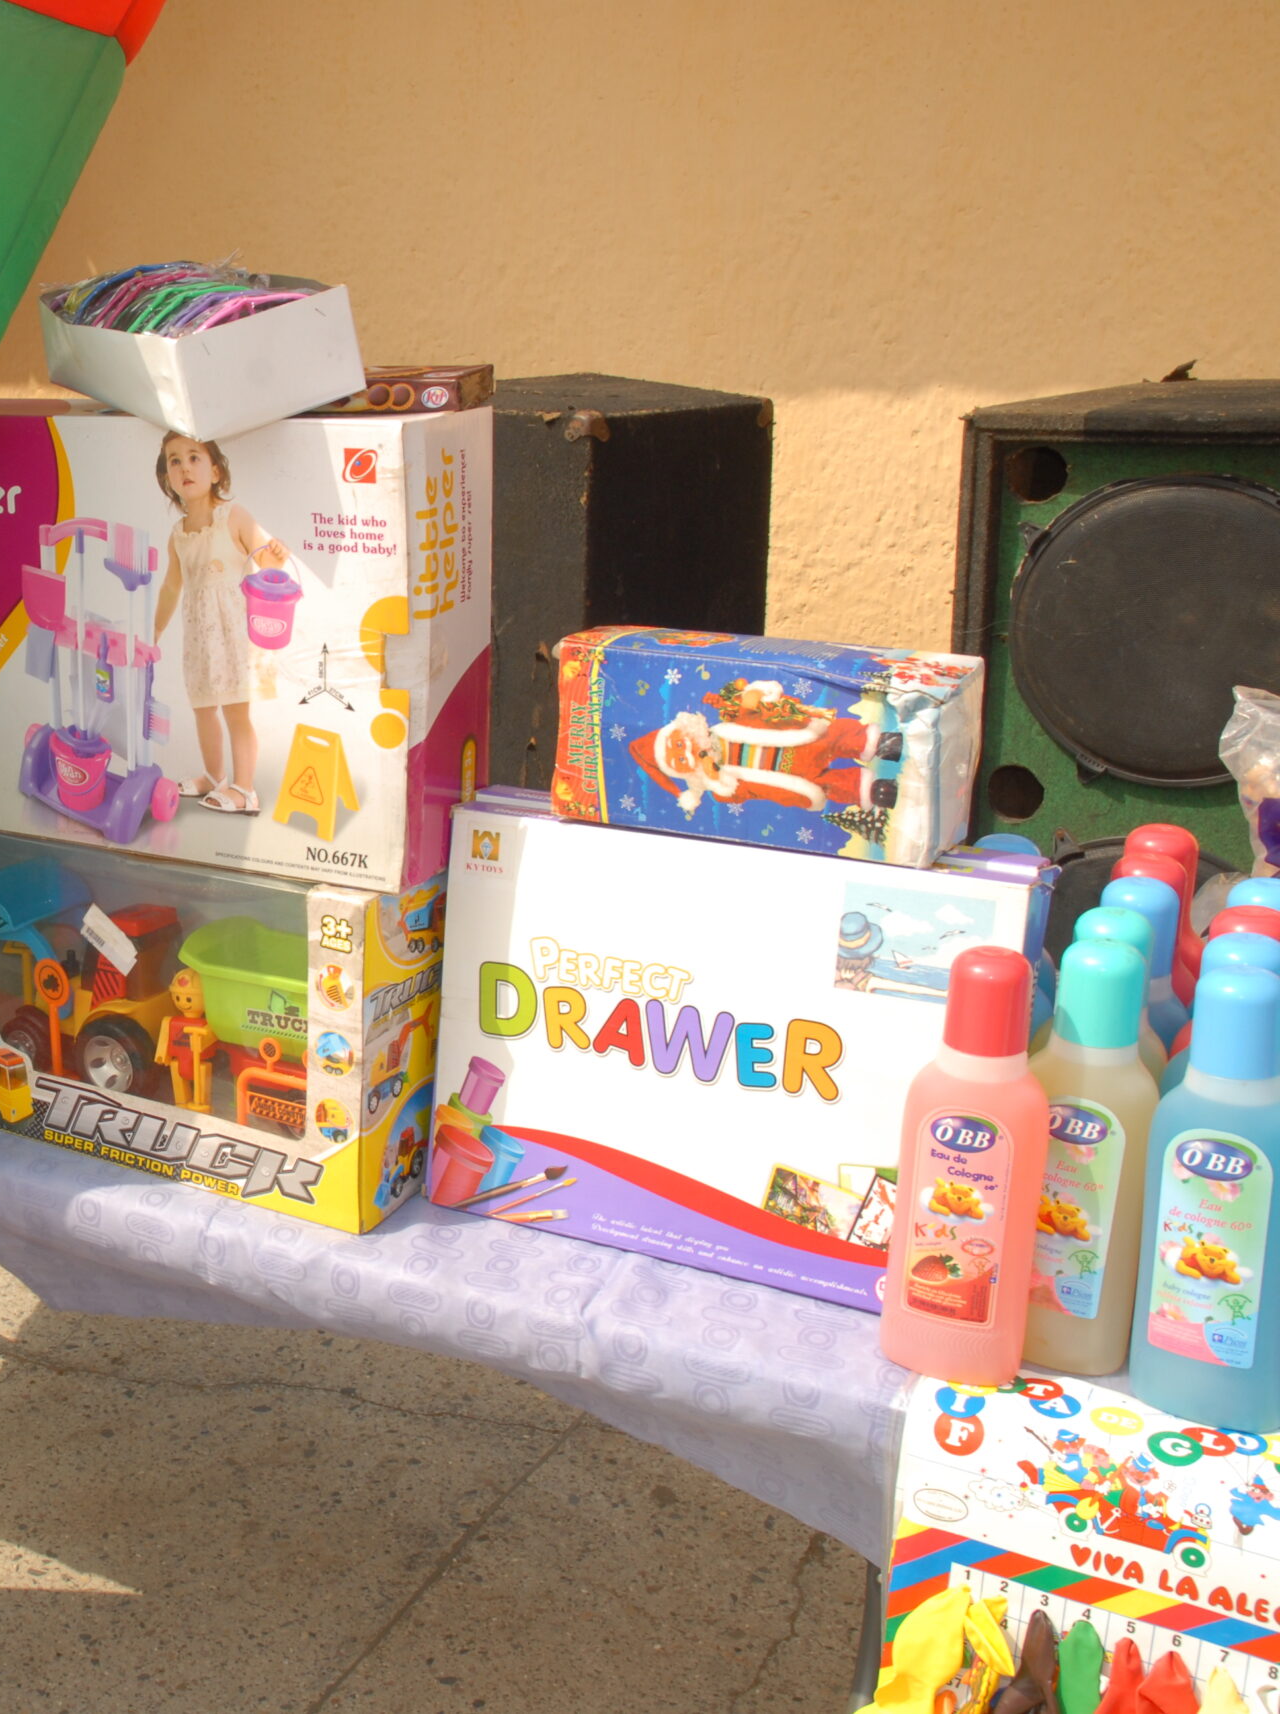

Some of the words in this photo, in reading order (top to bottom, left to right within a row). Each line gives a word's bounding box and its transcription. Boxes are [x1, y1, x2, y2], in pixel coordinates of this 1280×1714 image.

[311, 512, 334, 525] The
[337, 513, 357, 526] kid
[361, 515, 387, 528] who
[314, 526, 346, 539] loves
[350, 528, 384, 541] home
[439, 448, 460, 615] helper
[303, 540, 313, 551] is
[317, 543, 324, 551] a
[328, 542, 358, 554] good
[362, 543, 397, 557] baby!
[413, 475, 439, 621] Little
[567, 702, 590, 768] MERRY
[306, 847, 369, 869] NO.667K
[320, 915, 353, 939] 3+
[320, 935, 352, 954] AGES
[530, 936, 693, 1001] PERFECT
[478, 960, 844, 1102] DRAWER
[36, 1076, 324, 1204] TRUCK
[44, 1129, 94, 1152] SUPER
[100, 1146, 174, 1176] FRICTION
[180, 1169, 239, 1196] POWER
[931, 1149, 950, 1160] Eau
[953, 1155, 967, 1164] de
[1056, 1160, 1077, 1174] Eau
[947, 1166, 994, 1182] Cologne
[1199, 1199, 1222, 1212] Eau
[1168, 1206, 1182, 1217] de
[1184, 1213, 1228, 1228] cologne
[915, 1222, 957, 1241] Kids
[1070, 1544, 1144, 1584] VIVA
[1158, 1569, 1199, 1601] LA
[1208, 1586, 1280, 1626] ALE
[964, 1570, 971, 1580] 1
[1000, 1581, 1009, 1593] 2
[1040, 1594, 1049, 1606] 3
[1082, 1608, 1091, 1620] 4
[1126, 1621, 1136, 1634] 5
[1172, 1634, 1182, 1647] 6
[1220, 1649, 1230, 1662] 7
[1268, 1666, 1279, 1680] 8
